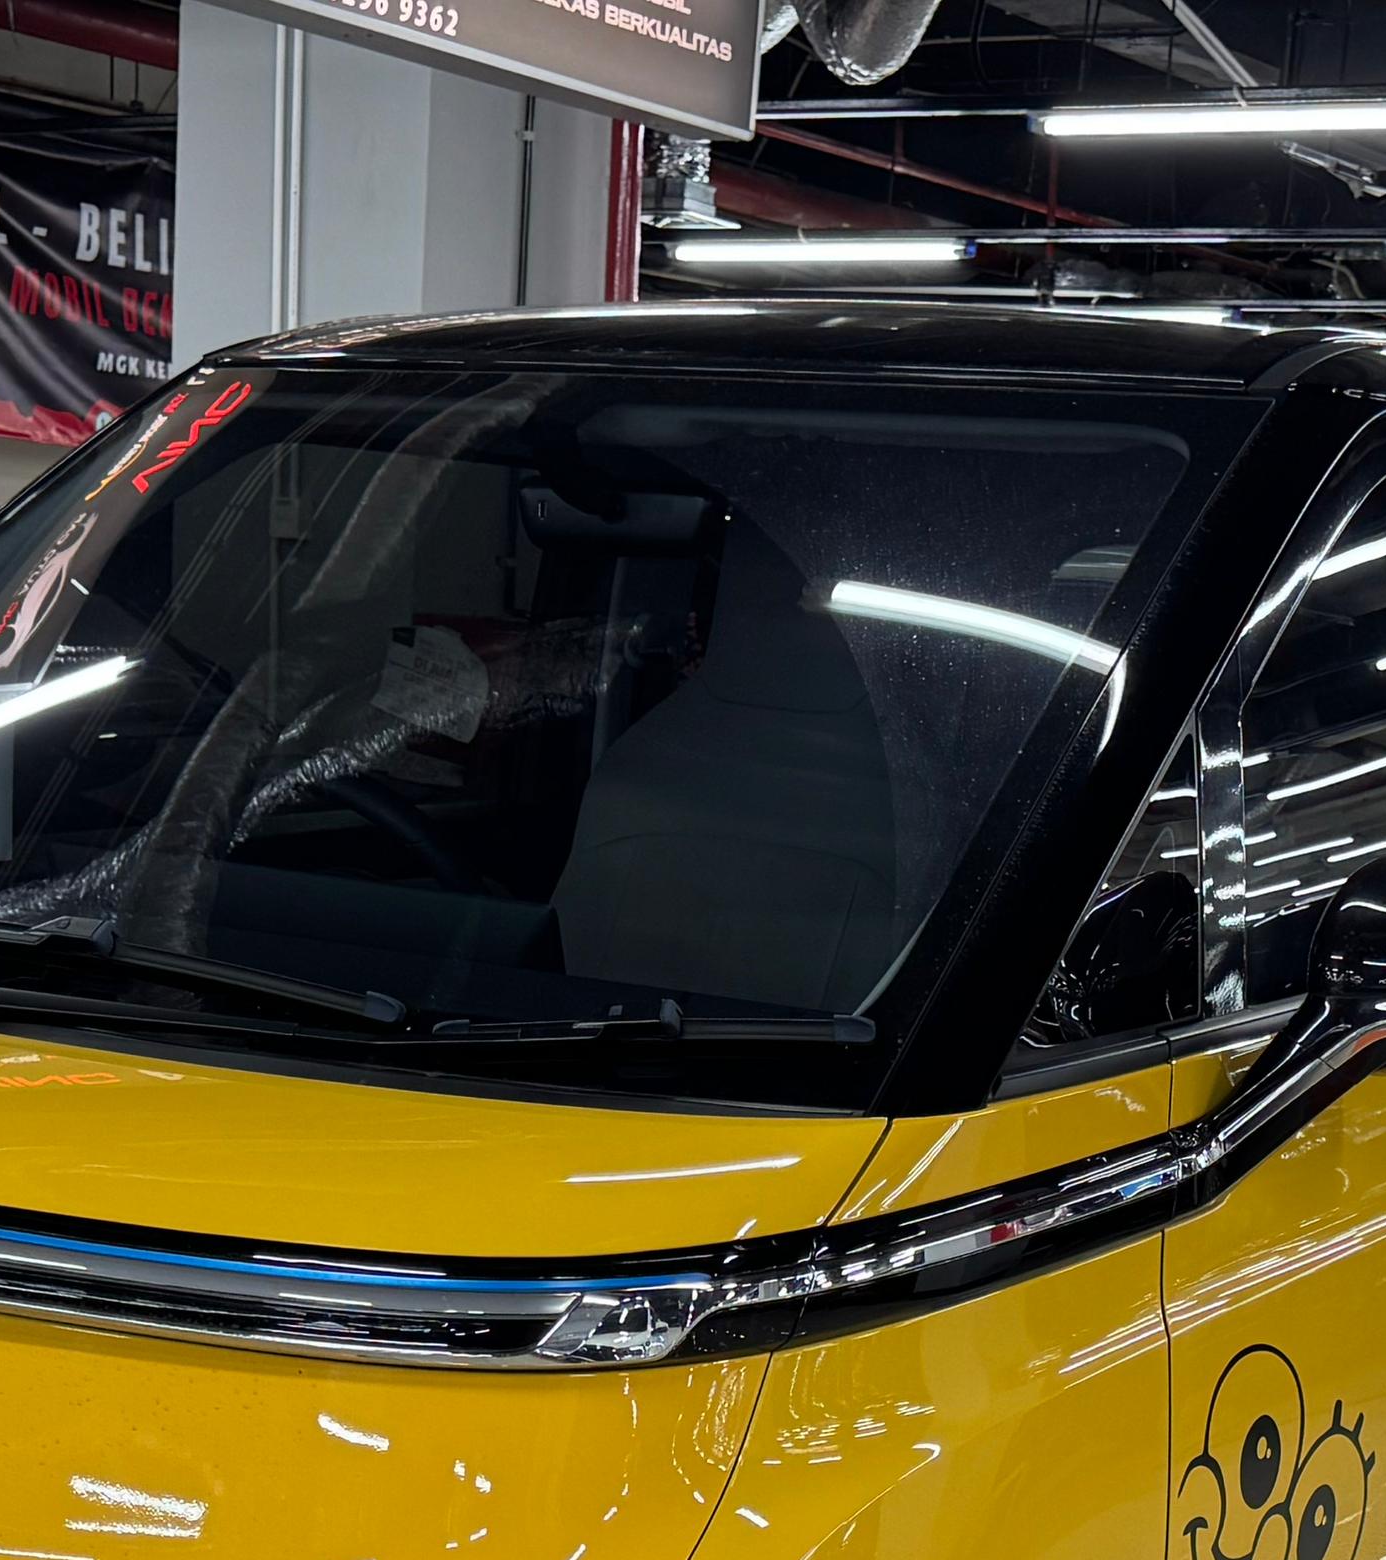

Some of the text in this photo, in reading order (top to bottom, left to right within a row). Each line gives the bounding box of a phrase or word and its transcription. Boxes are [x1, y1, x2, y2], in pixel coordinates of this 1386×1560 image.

[604, 4, 733, 62] BERKUALITAS
[75, 202, 171, 276] BELI
[9, 264, 111, 329] MOBIL
[95, 351, 140, 377] MGK
